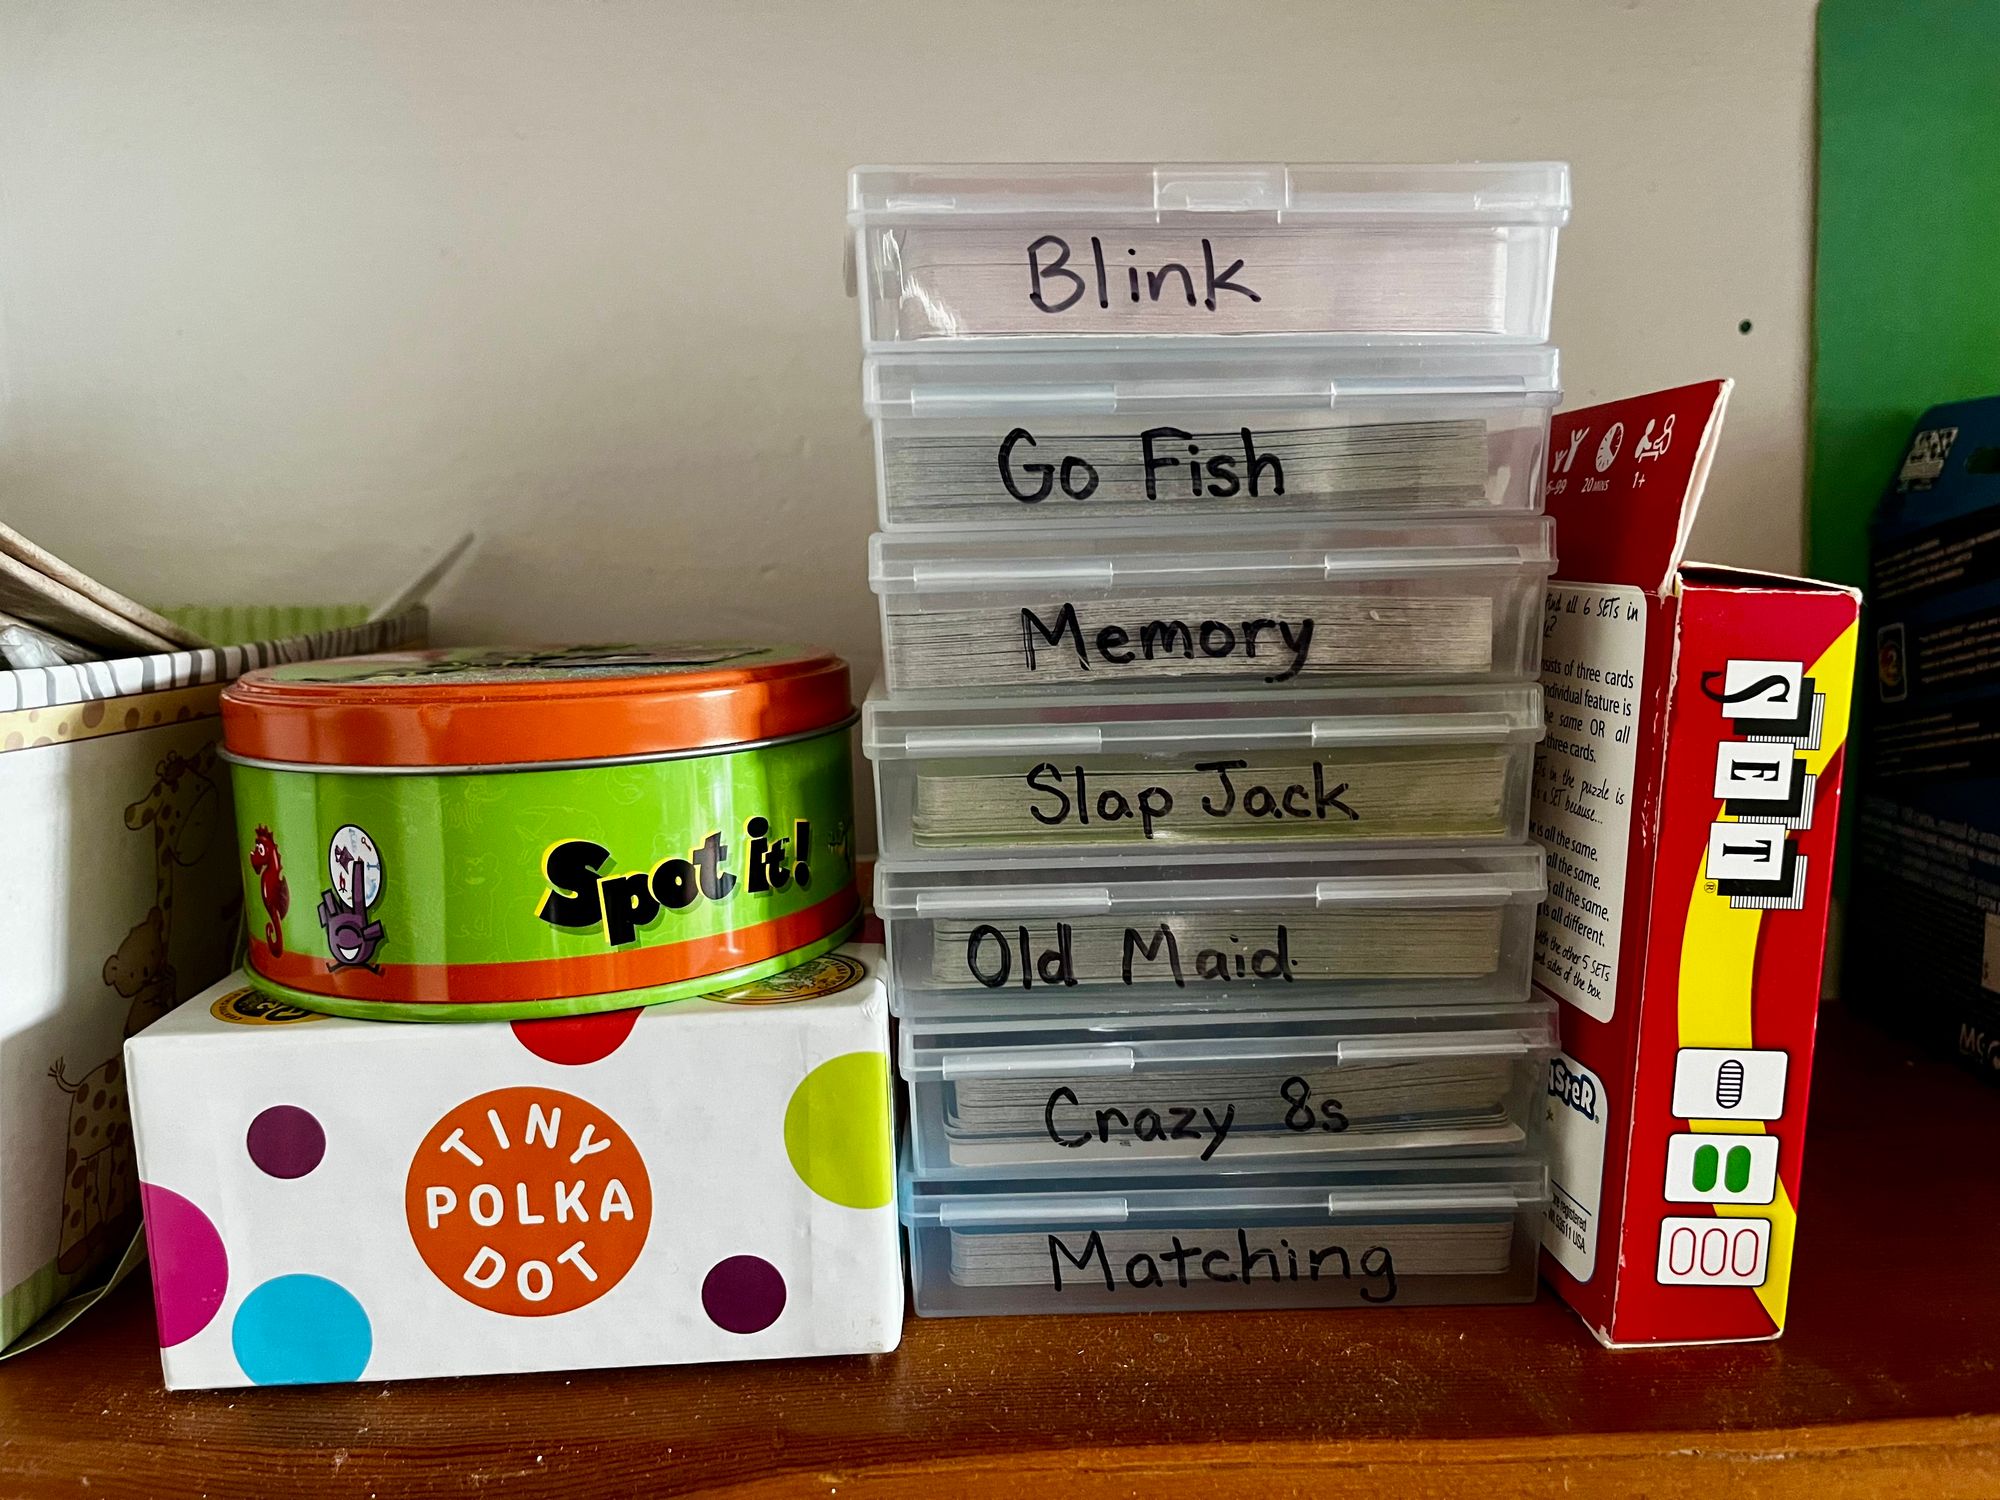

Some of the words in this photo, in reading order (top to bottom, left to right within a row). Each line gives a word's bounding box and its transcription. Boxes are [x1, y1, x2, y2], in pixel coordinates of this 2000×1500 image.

[1029, 234, 1263, 314] Blink
[998, 427, 1099, 503] Go
[1139, 426, 1286, 501] Fish
[1632, 471, 1646, 488] 1+
[1566, 595, 1579, 613] all
[1583, 597, 1591, 616] 6
[1597, 597, 1620, 620] SETs
[1627, 601, 1639, 622] in
[1021, 602, 1315, 684] Memory
[1541, 657, 1561, 674] nsists
[1564, 659, 1575, 676] of
[1577, 661, 1601, 683] three
[1605, 669, 1634, 689] cards
[1584, 688, 1620, 715] feature
[1623, 699, 1632, 716] is
[1546, 731, 1568, 754] three
[1569, 742, 1597, 763] cards.
[1559, 714, 1583, 732] same
[1590, 719, 1606, 738] OR
[1615, 725, 1631, 744] all
[1562, 768, 1576, 789] the
[1579, 778, 1609, 802] puzzle
[1615, 787, 1625, 806] is
[1702, 671, 1790, 863] SET
[1026, 762, 1174, 840] Slap
[1194, 759, 1360, 823] Jack
[1544, 825, 1556, 843] all
[1556, 829, 1571, 850] the
[1571, 842, 1598, 862] same.
[534, 829, 738, 948] Spot
[743, 814, 812, 895] it!
[1546, 852, 1557, 869] all
[1558, 856, 1572, 877] the
[1573, 867, 1601, 890] same.
[1552, 881, 1564, 899] all
[1565, 886, 1580, 907] the
[1581, 898, 1609, 922] same.
[1542, 903, 1550, 917] is
[1551, 906, 1563, 925] all
[1563, 911, 1605, 947] different.
[966, 921, 1078, 991] Old
[1550, 936, 1561, 954] the
[1562, 945, 1581, 965] other
[1582, 954, 1590, 970] 5
[1591, 960, 1611, 982] SETs
[1573, 971, 1585, 991] the
[439, 1102, 611, 1167] TINY
[1045, 1085, 1236, 1162] Crazy
[1280, 1076, 1350, 1136] 8s
[426, 1178, 634, 1229] POLKA
[1572, 1230, 1586, 1254] USA
[463, 1240, 598, 1302] DOT
[1048, 1227, 1398, 1304] Matching
